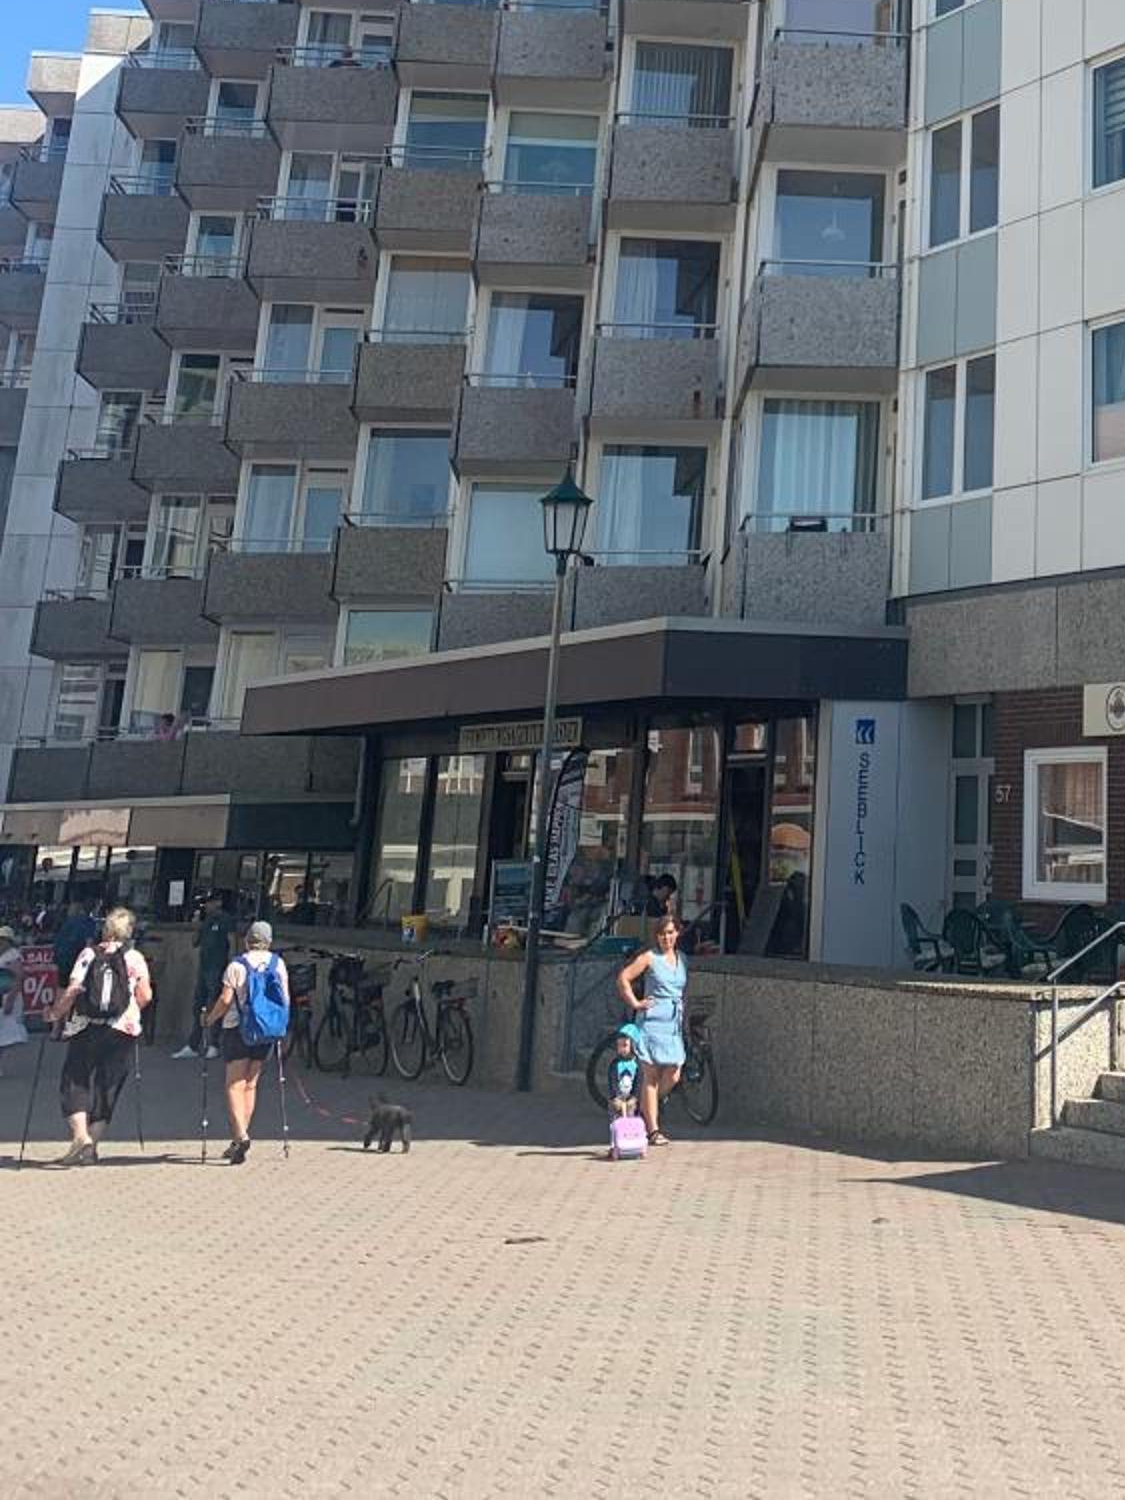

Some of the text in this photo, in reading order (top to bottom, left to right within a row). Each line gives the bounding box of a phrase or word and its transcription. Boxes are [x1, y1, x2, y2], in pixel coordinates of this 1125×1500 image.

[994, 783, 1013, 804] 57
[854, 752, 870, 885] SEEBLICK
[22, 972, 54, 1007] %
